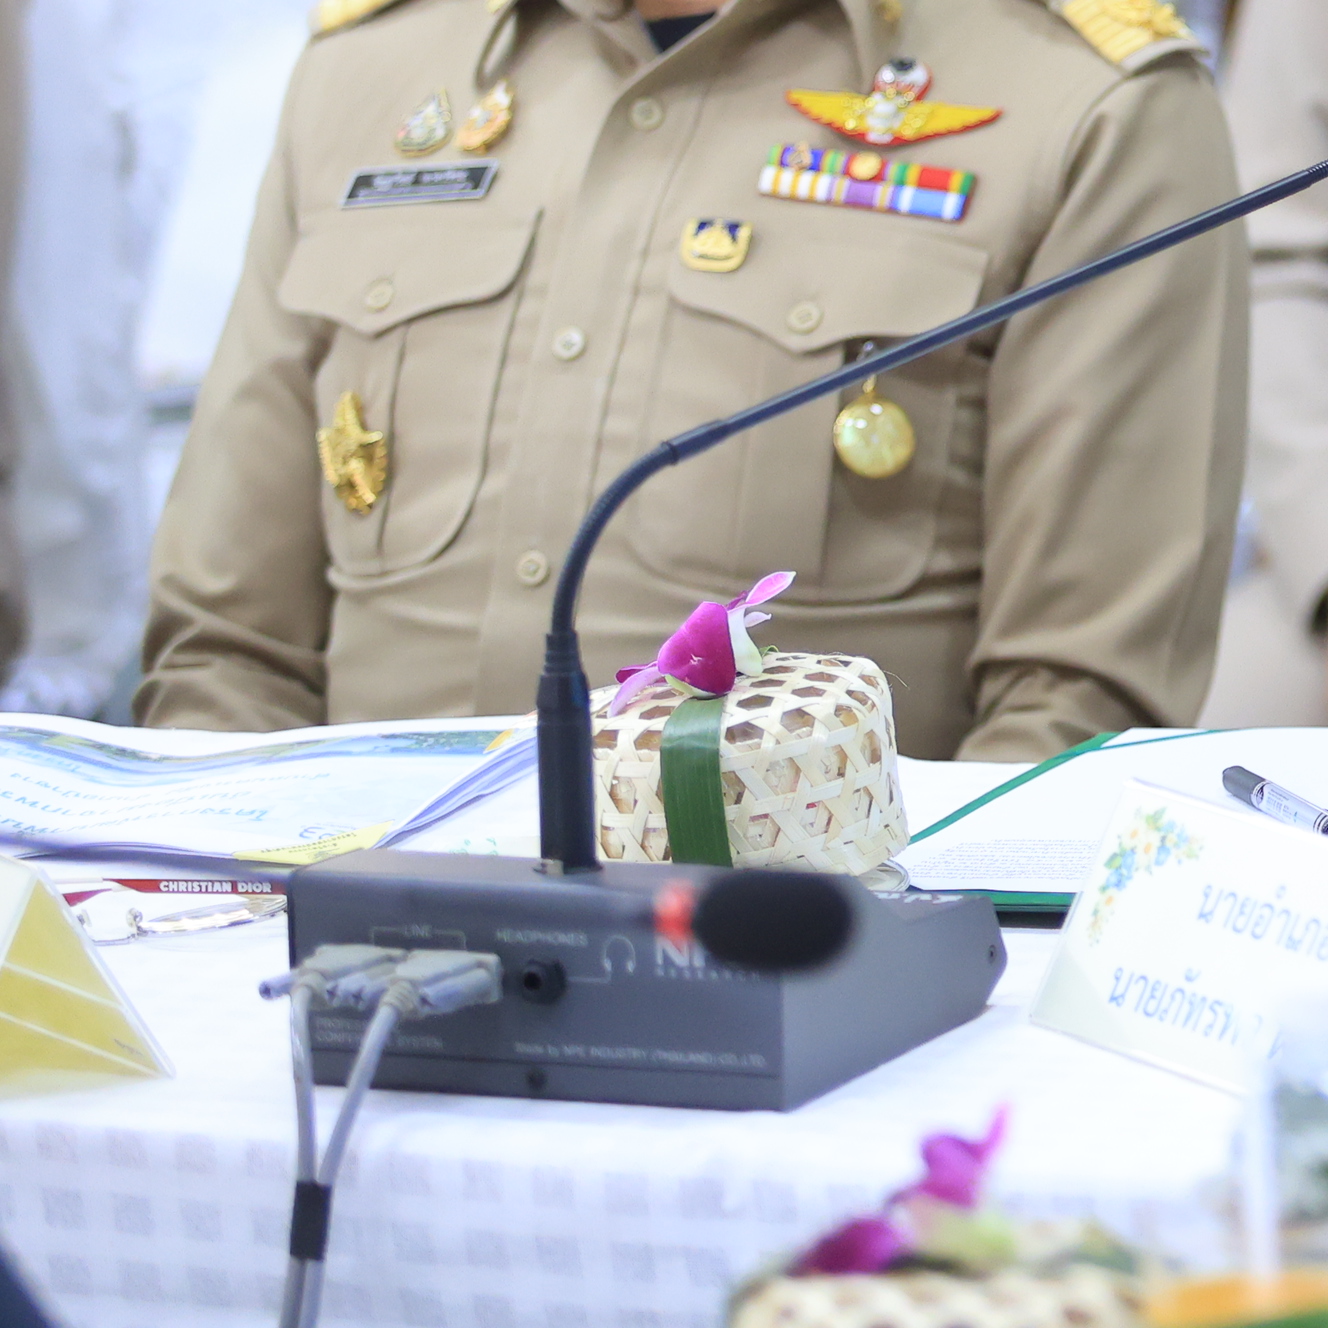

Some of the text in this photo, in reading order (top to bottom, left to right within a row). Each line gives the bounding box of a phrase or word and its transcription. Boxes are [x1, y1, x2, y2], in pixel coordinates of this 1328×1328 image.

[159, 880, 272, 894] CHRISTIAN DIOR
[496, 928, 588, 947] HEADPHONES
